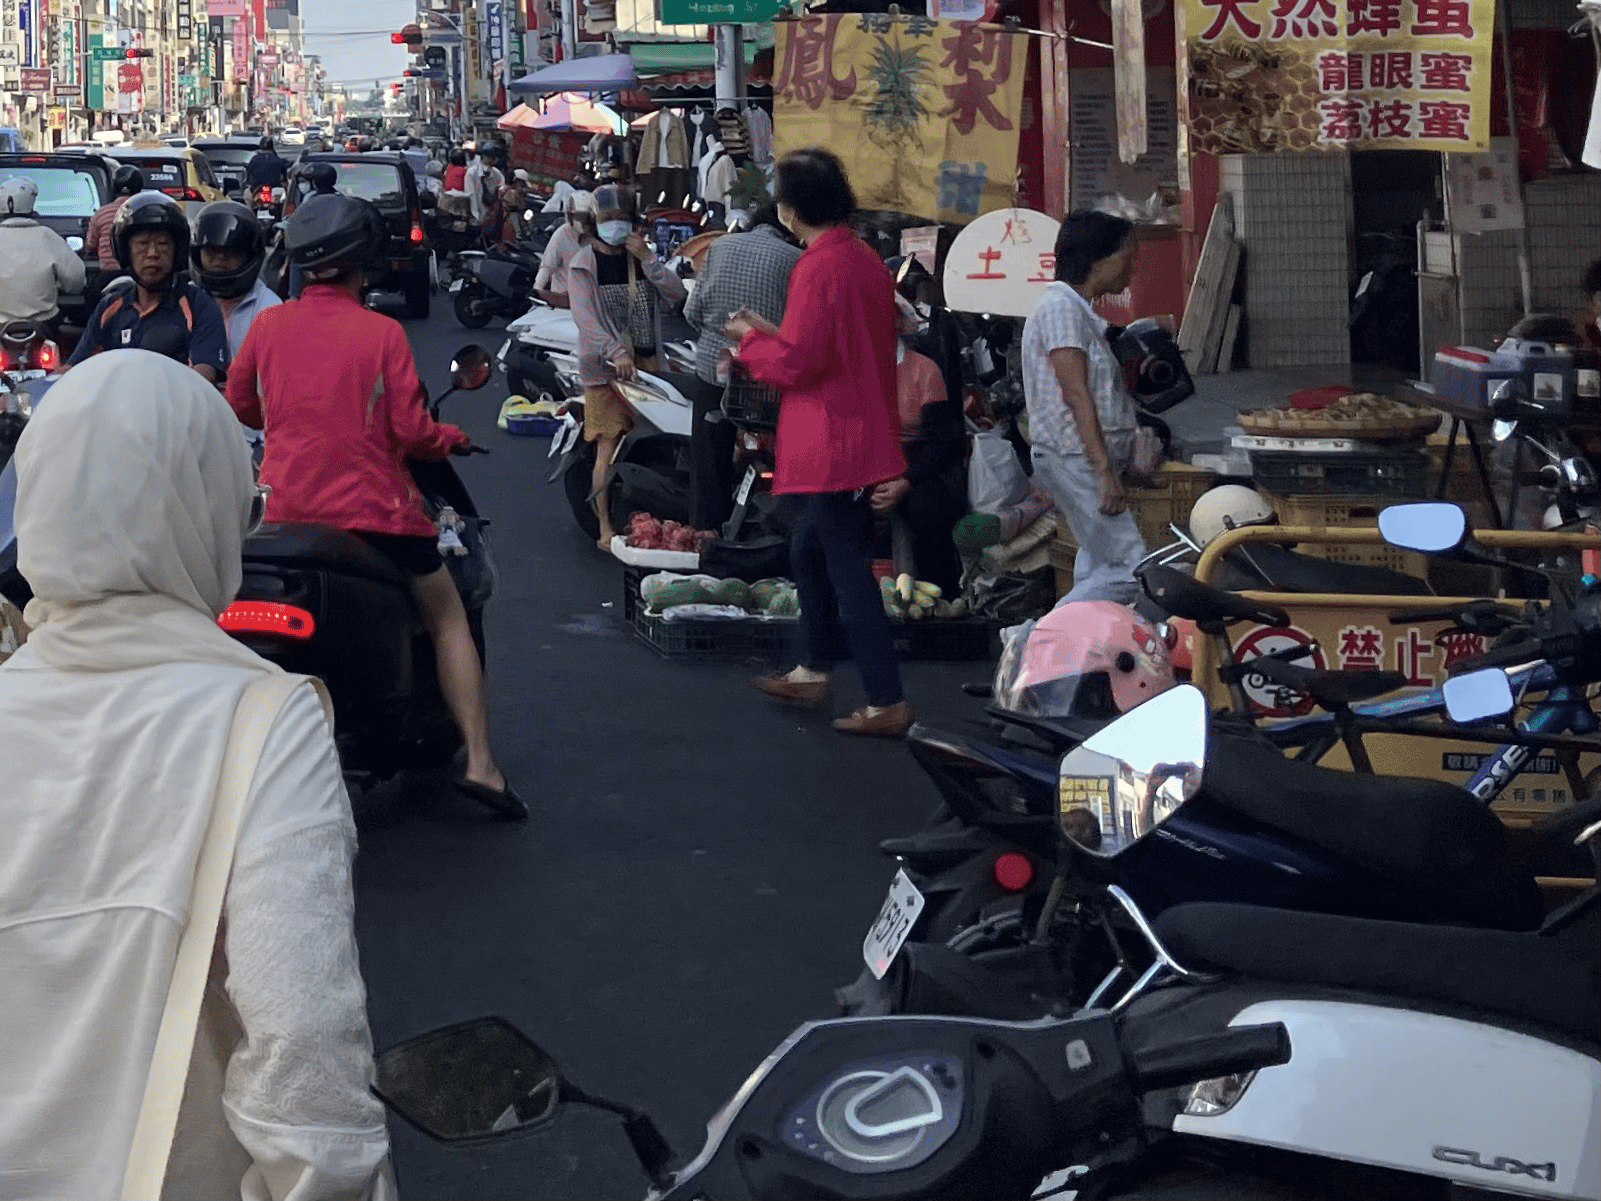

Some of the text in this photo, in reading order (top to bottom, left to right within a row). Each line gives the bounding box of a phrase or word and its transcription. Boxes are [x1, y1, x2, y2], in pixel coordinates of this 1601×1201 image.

[1318, 50, 1473, 92] 龍眼蜜
[1320, 99, 1472, 141] 荔枝蜜
